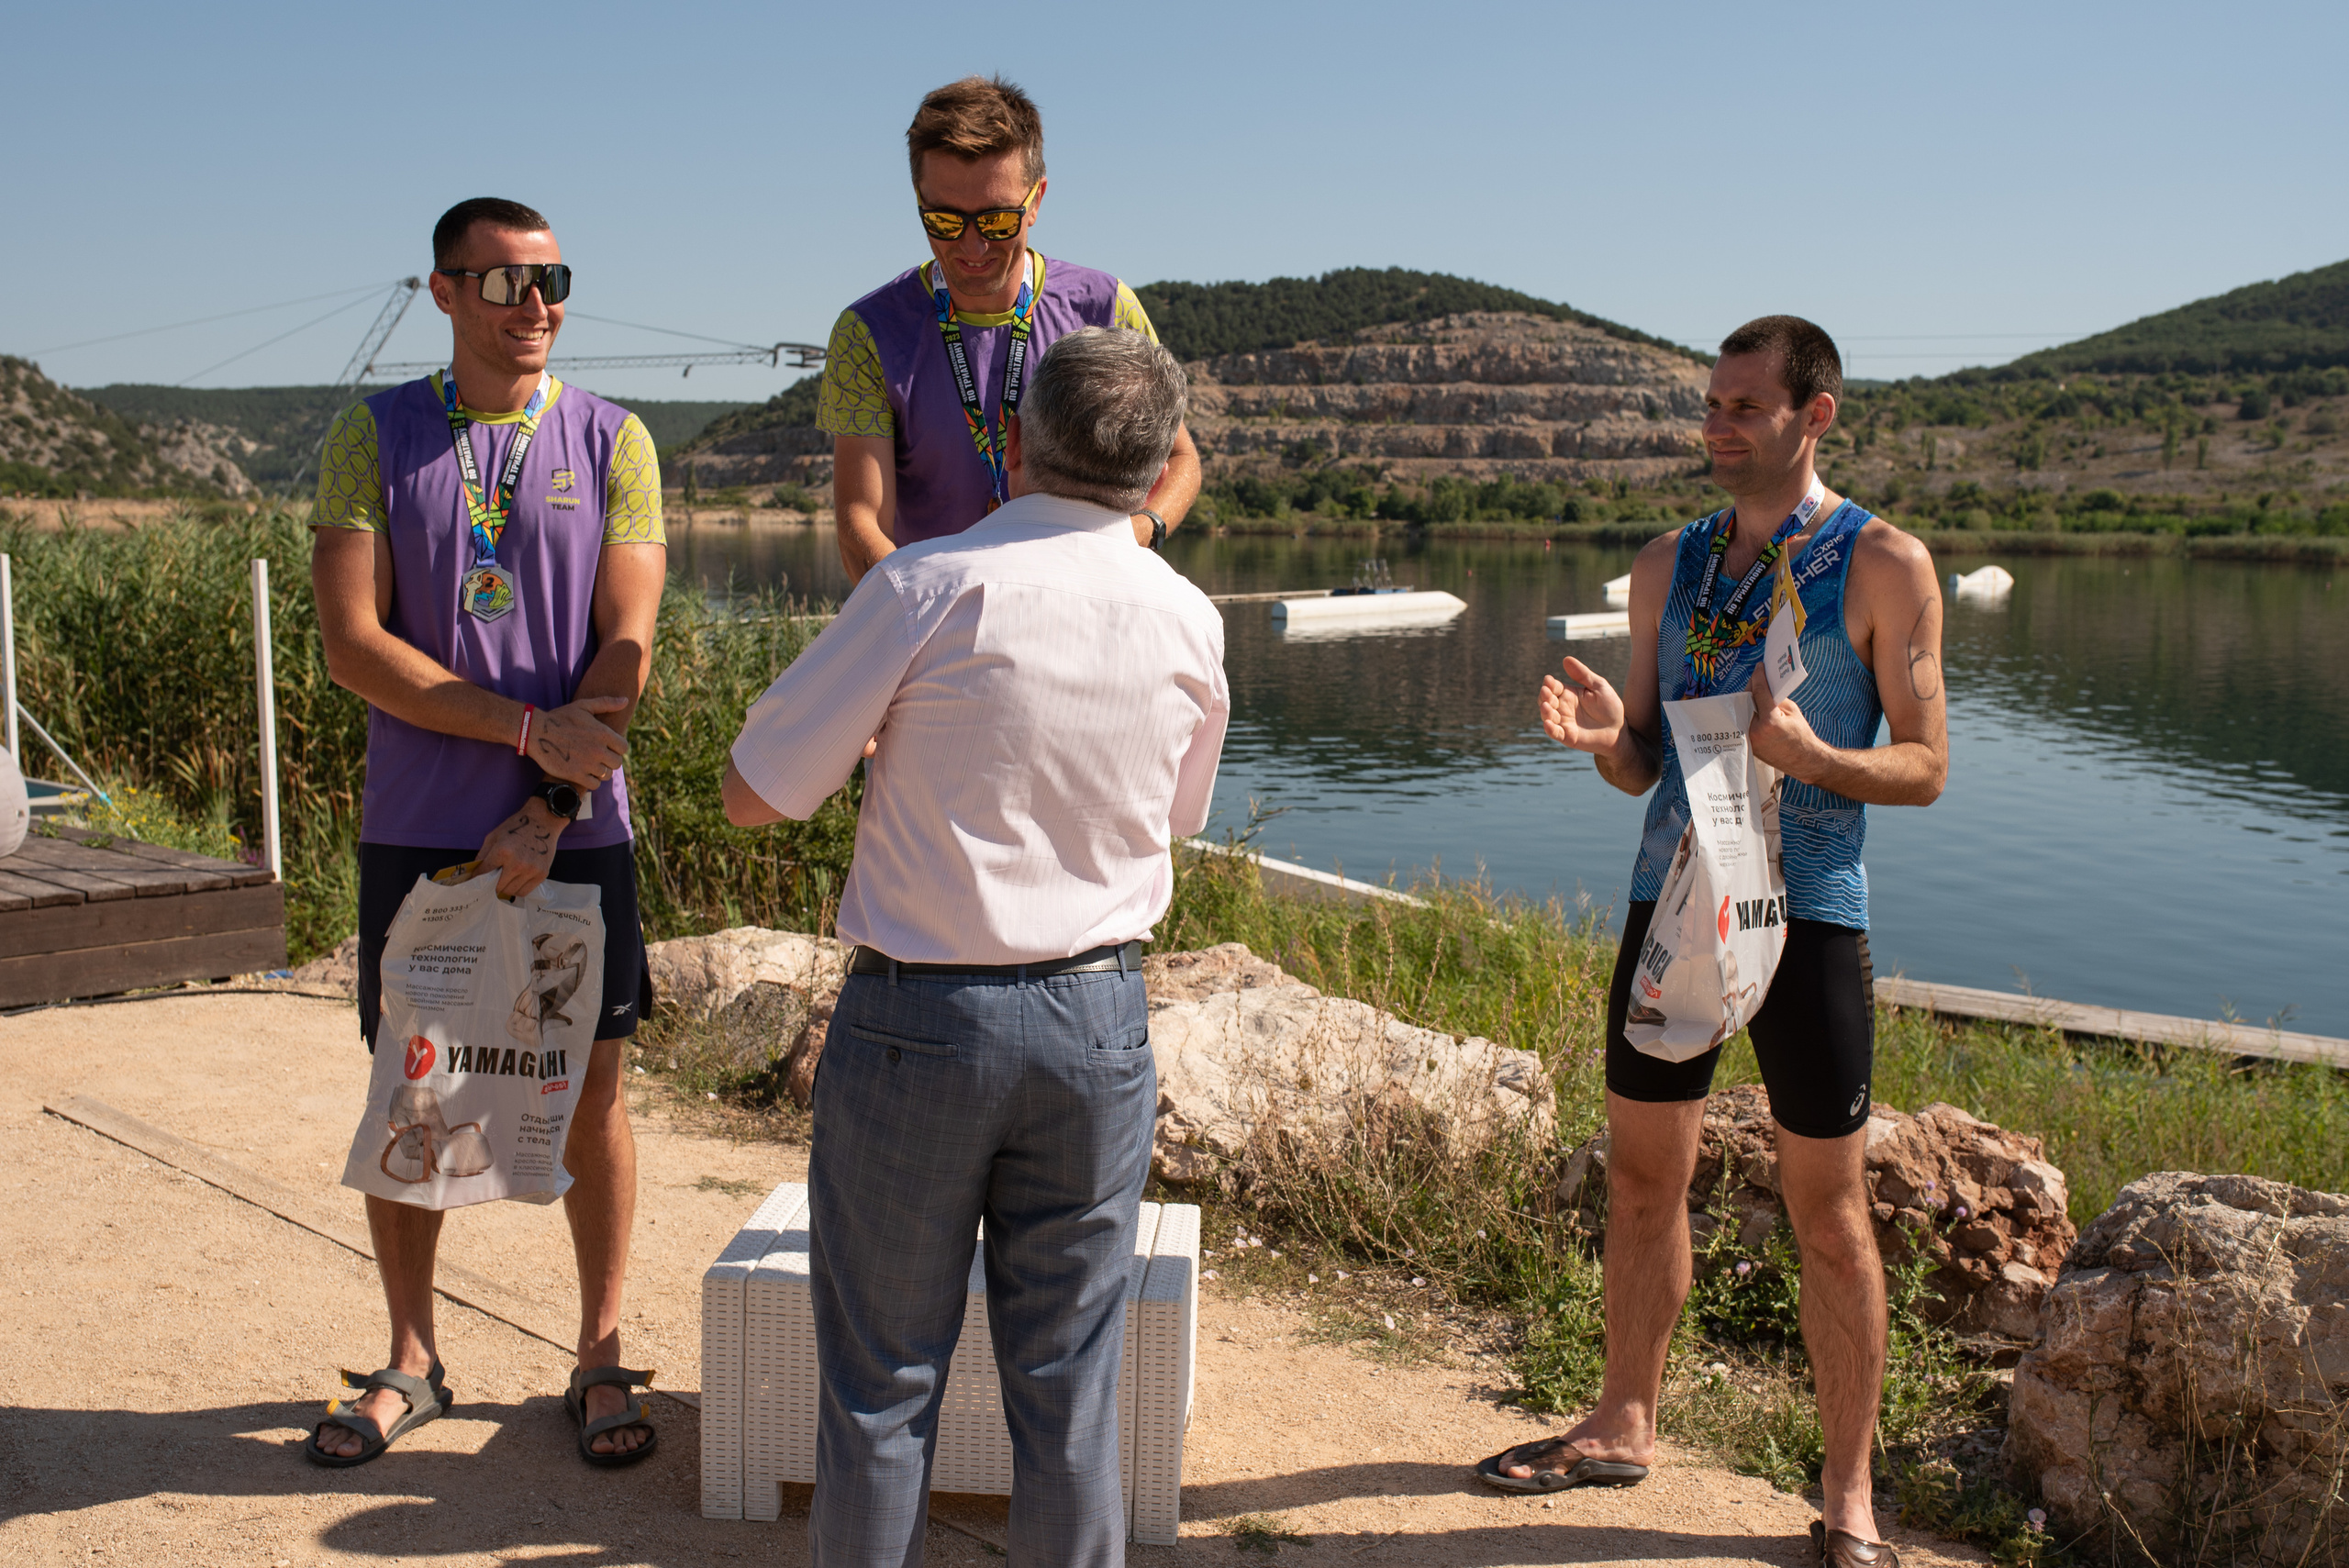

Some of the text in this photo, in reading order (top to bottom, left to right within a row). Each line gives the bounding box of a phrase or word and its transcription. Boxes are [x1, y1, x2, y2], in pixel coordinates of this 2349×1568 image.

[945, 333, 960, 343] 2023
[1012, 330, 1028, 339] 2023
[952, 342, 976, 402] ПО ТРИАТЛОНУ
[1008, 339, 1026, 402] ПО ТРИАТЛОНУ
[518, 426, 534, 436] 2023
[459, 428, 477, 480] ПО ТРИАТЛОНУ
[507, 433, 531, 485] ПО ТРИАТЛОНУ
[545, 495, 580, 505] SHARUN
[484, 577, 495, 587] 2
[1699, 554, 1720, 607] ПО ТРИАТЛОНУ
[1727, 603, 1738, 615] ПО
[1736, 562, 1766, 604] ТРИАТЛОНУ
[1697, 733, 1712, 741] 800
[1712, 817, 1717, 827] у
[411, 954, 478, 963] технологии
[442, 966, 472, 974] дома
[406, 984, 444, 992] Массажное
[527, 1137, 551, 1145] тела
